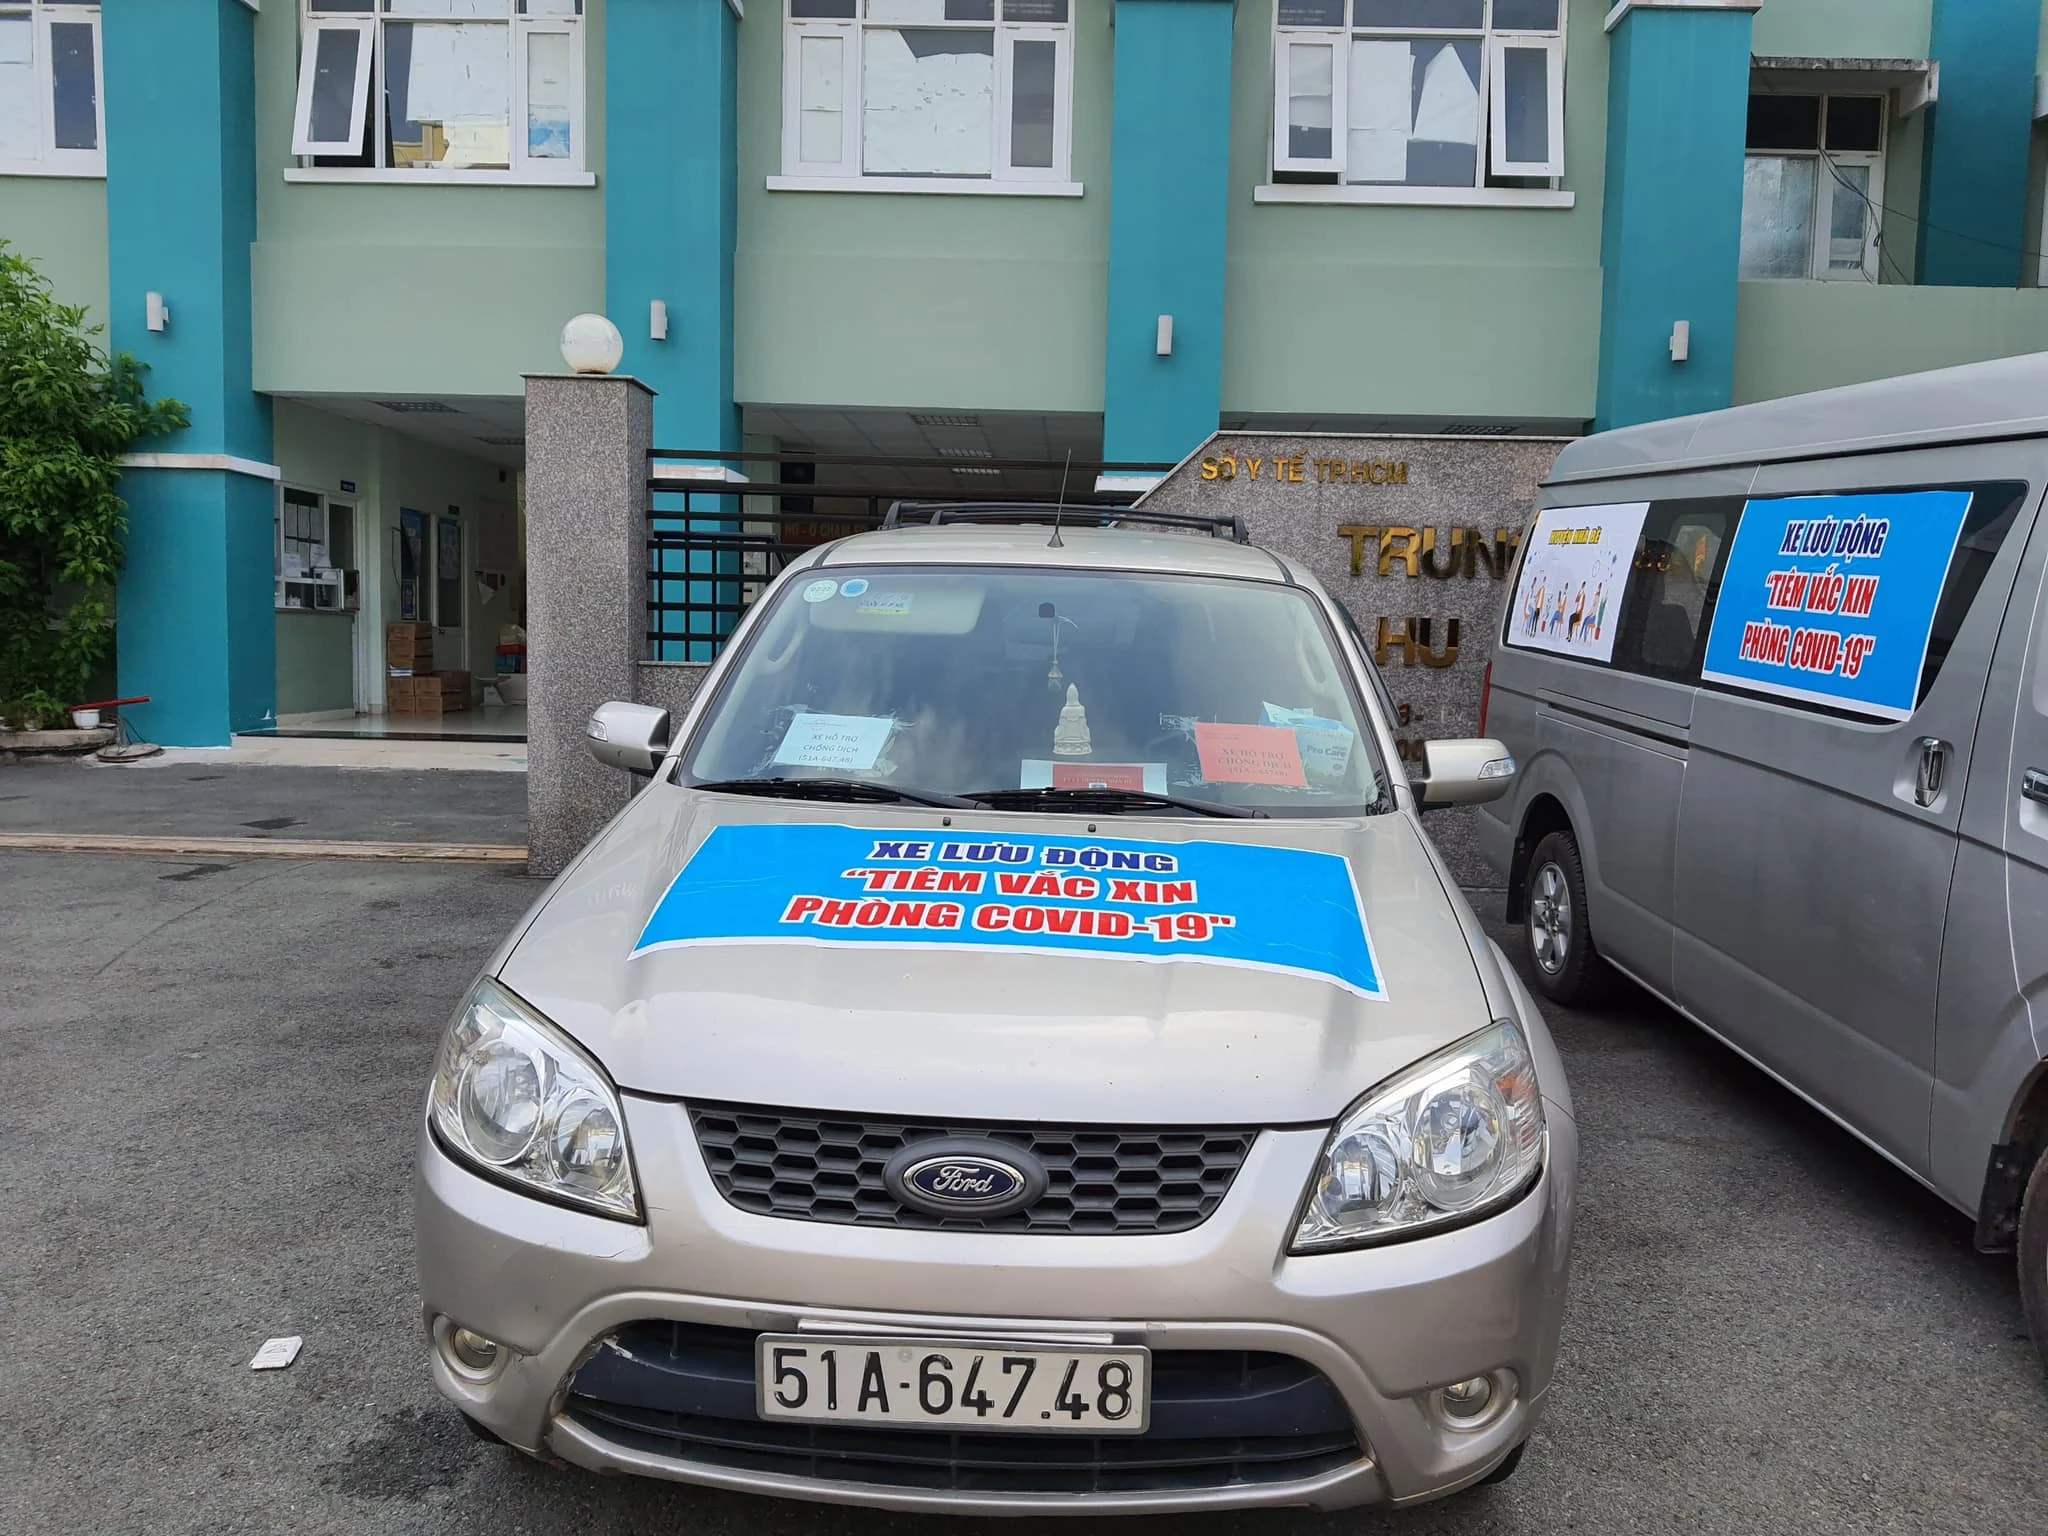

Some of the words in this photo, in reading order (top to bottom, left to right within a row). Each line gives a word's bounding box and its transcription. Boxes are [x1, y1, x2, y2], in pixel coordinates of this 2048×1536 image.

[1201, 449, 1238, 481] SỞ
[1245, 457, 1263, 482] Y
[1272, 449, 1309, 482] TẾ
[1338, 525, 1522, 579] TRUN
[1781, 522, 1806, 553] XE
[1801, 516, 1839, 555] LƯU
[1834, 515, 1888, 560] ĐỘNG
[1806, 566, 1843, 612] VẮC
[1841, 577, 1878, 615] XIN
[1741, 620, 1791, 664] PHÒNG
[872, 842, 930, 859] XE
[941, 842, 1031, 863] LƯU
[1044, 847, 1175, 872] ĐỘNG
[998, 869, 1097, 898] VẮC
[1111, 879, 1196, 903] XIN
[785, 897, 962, 929] PHÒNG
[932, 1165, 994, 1194] Ford
[772, 1347, 1133, 1421] 51A-647.48
